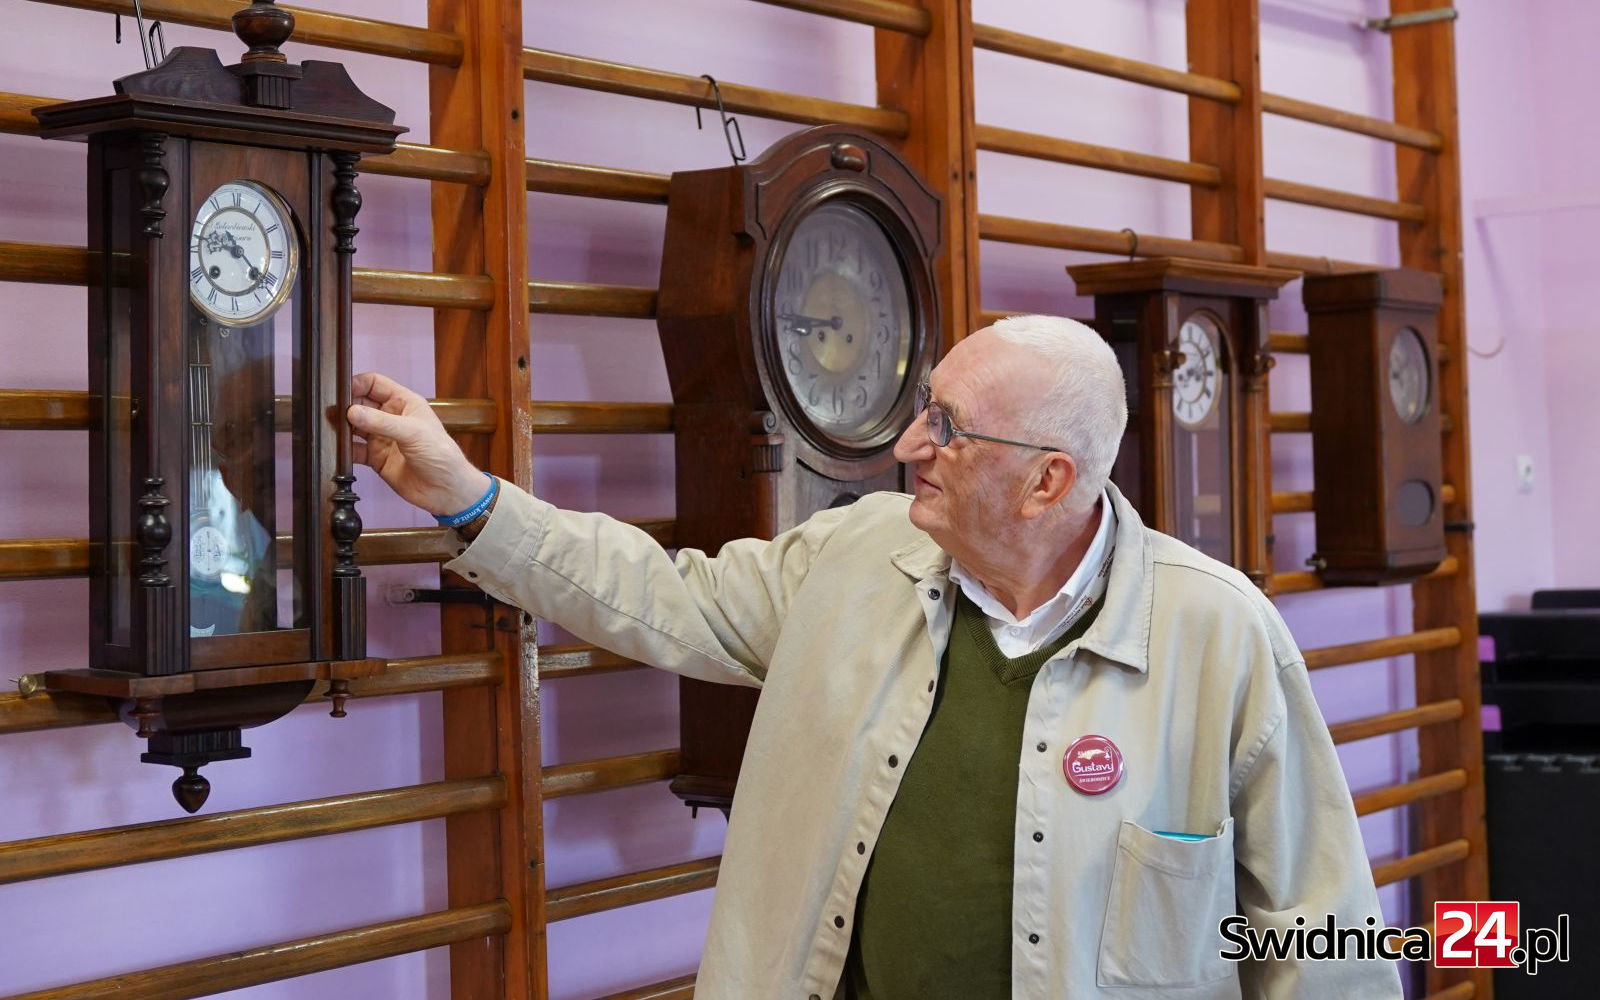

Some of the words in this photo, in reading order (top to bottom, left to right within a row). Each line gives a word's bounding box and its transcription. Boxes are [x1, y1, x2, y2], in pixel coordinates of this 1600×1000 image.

[828, 231, 847, 263] 12
[869, 270, 882, 303] 2
[788, 343, 803, 376] 8
[831, 383, 844, 417] 6
[1072, 759, 1115, 775] Gustavy
